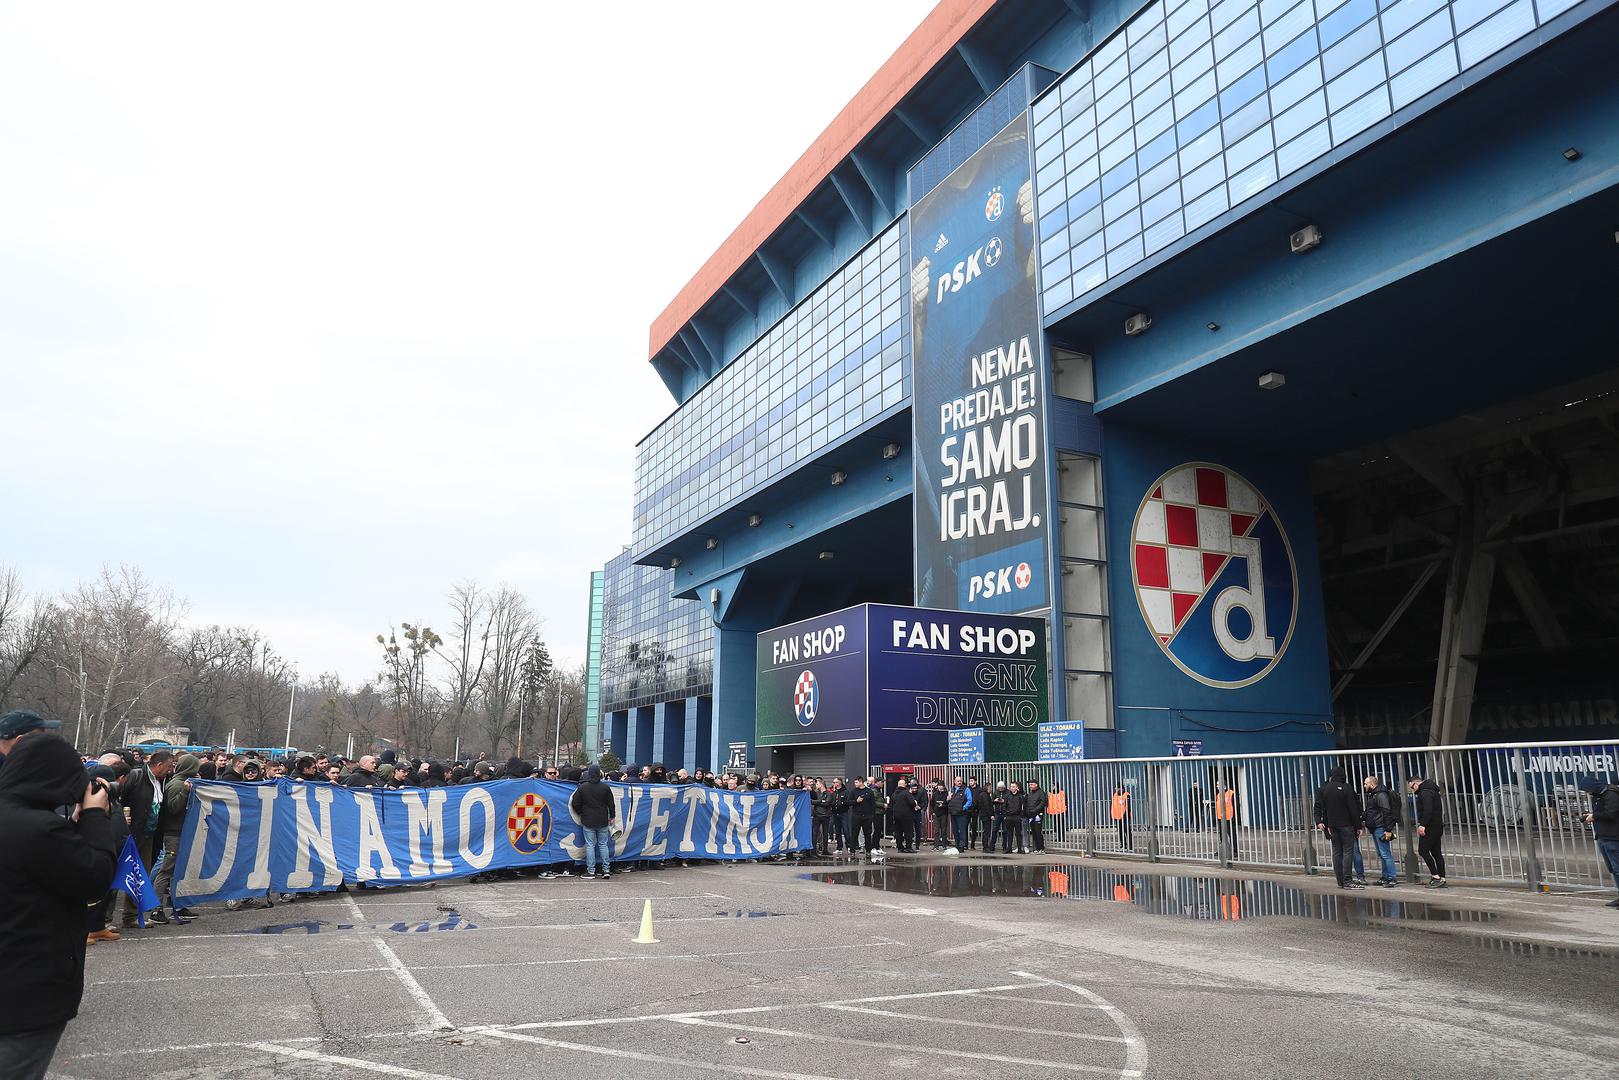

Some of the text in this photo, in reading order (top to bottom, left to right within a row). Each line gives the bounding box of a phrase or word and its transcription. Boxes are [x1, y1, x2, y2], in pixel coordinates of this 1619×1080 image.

[937, 247, 983, 304] PSK
[971, 336, 1034, 389] NEMA
[940, 372, 1036, 434] PREDAJE!
[940, 413, 1037, 487] SAMO
[940, 475, 1041, 541] IGRAJ.
[968, 565, 1014, 602] PSK
[773, 624, 846, 665] FAN SHOP
[893, 620, 1037, 655] FAN SHOP
[974, 662, 1038, 692] GNK
[915, 697, 1039, 728] DINAMO
[1466, 699, 1619, 731] AKSIMIR
[176, 784, 496, 898] DINAMO
